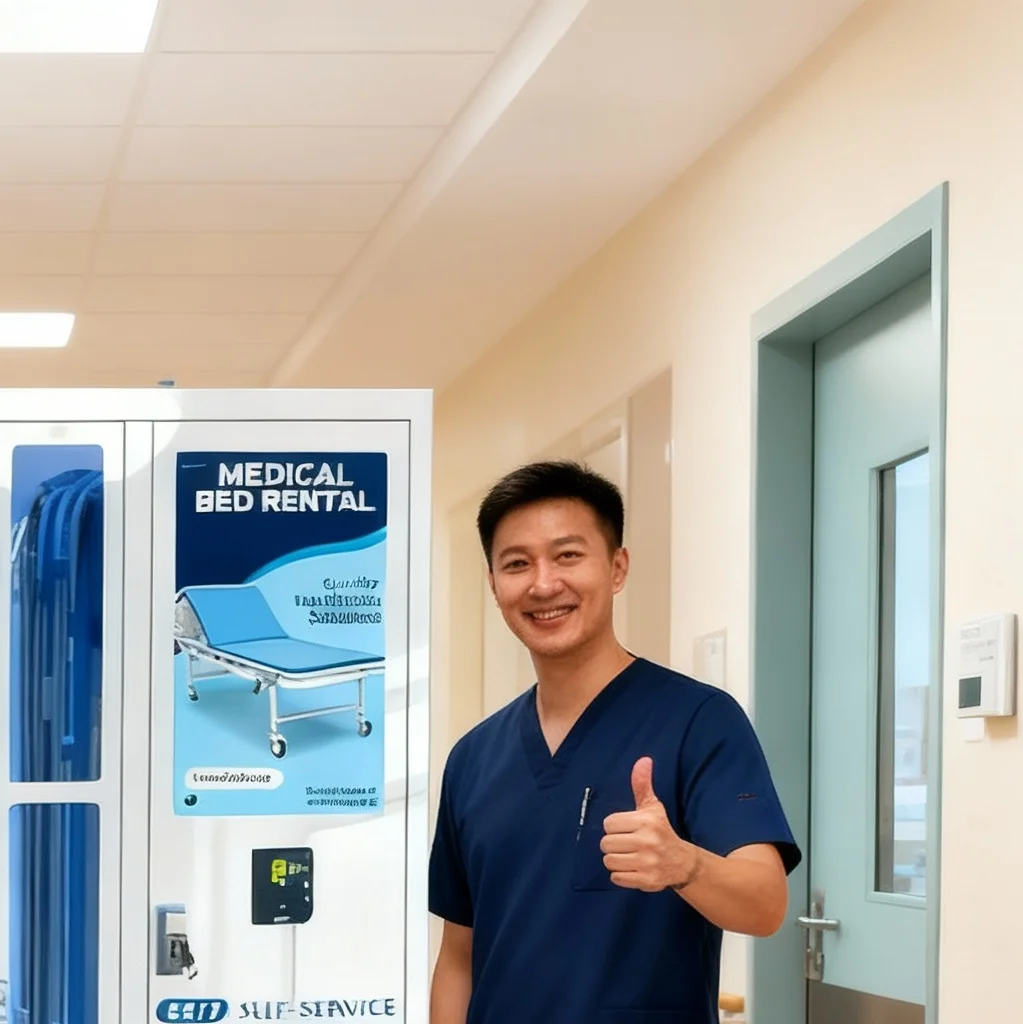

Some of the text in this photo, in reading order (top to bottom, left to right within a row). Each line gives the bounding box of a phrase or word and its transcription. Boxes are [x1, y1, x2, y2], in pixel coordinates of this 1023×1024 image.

[218, 462, 354, 487] MEDICAL
[195, 490, 377, 512] BED RENTAL
